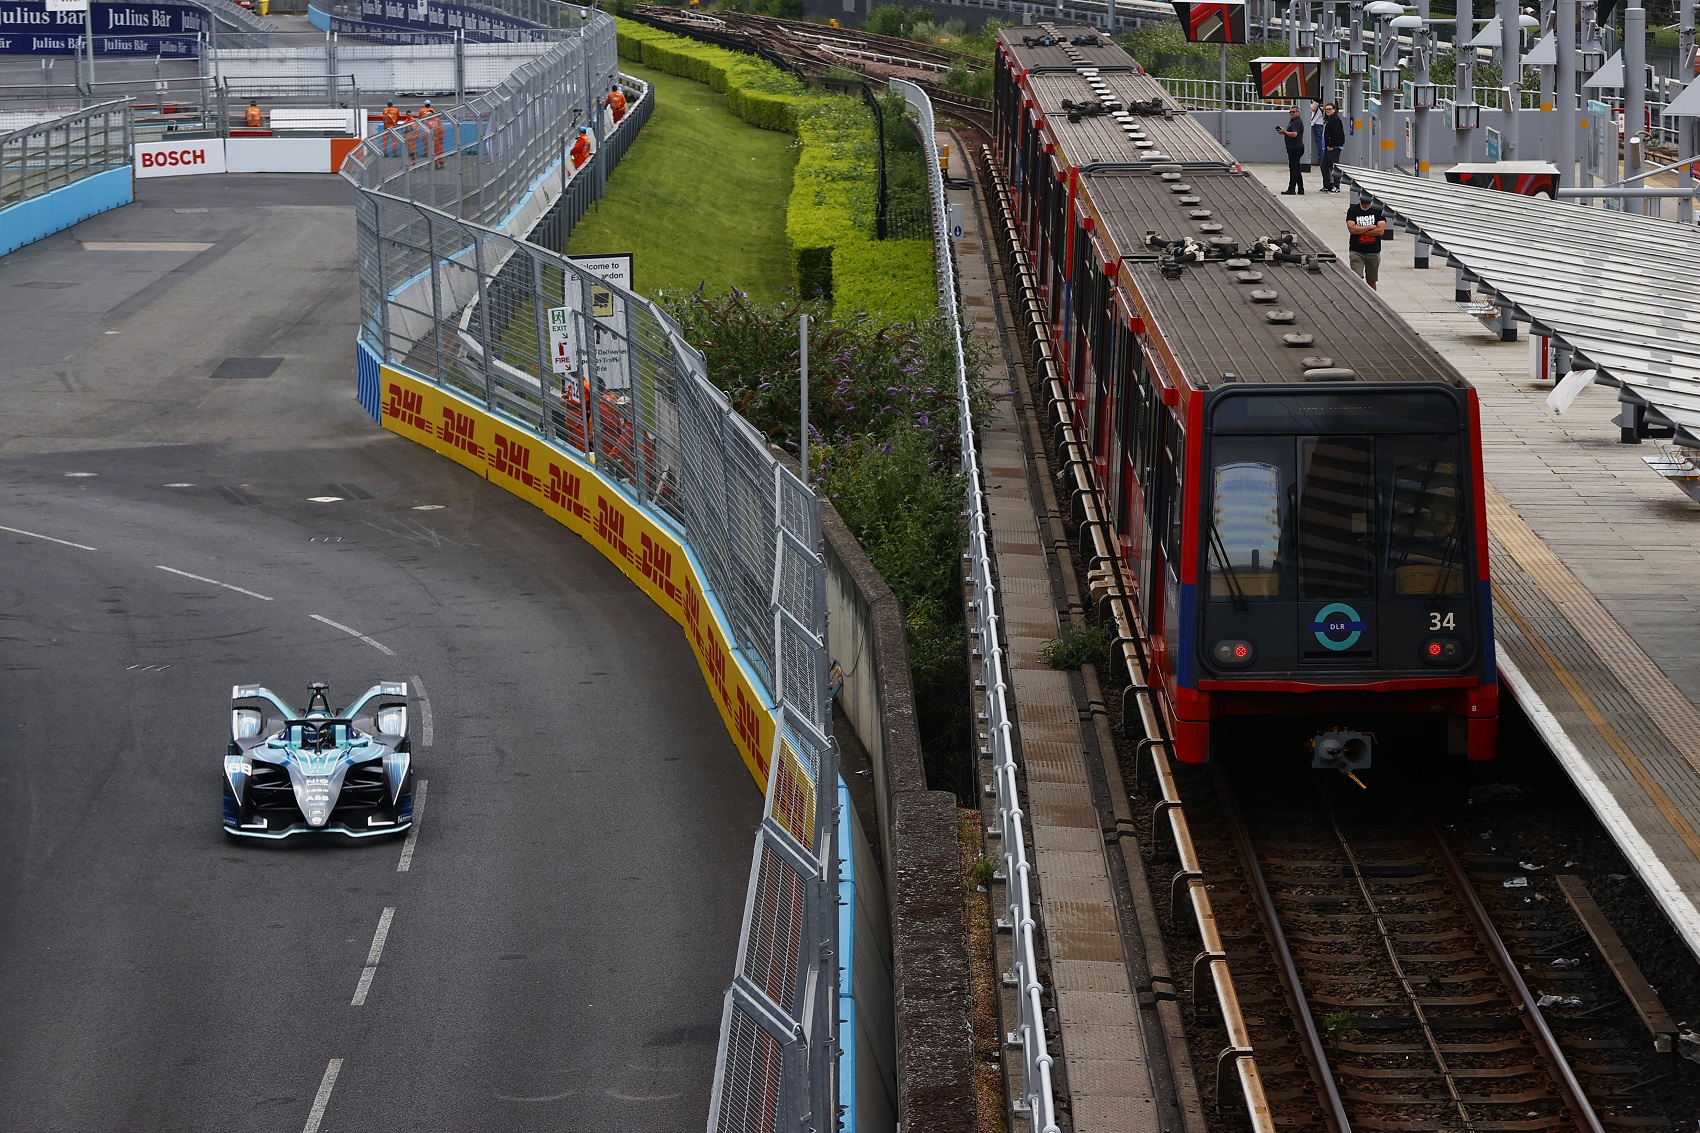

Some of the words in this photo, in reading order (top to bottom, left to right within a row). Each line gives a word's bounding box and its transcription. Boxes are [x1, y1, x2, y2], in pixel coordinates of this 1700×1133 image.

[0, 7, 50, 25] ulius
[108, 8, 149, 29] Julius
[152, 10, 172, 27] Bär
[0, 38, 12, 48] är
[32, 37, 65, 50] Julius
[104, 39, 132, 51] Julius
[134, 40, 148, 51] Bär
[141, 149, 205, 168] BOSCH
[389, 383, 426, 431] DHL
[443, 406, 478, 457] DHL
[494, 433, 533, 488] DHL
[549, 462, 584, 519] DHL
[598, 495, 628, 559] DHL
[641, 531, 676, 600] DHL
[685, 574, 701, 646] DHL
[1429, 612, 1456, 631] 34
[708, 624, 727, 710] DHL
[737, 684, 764, 774] DHL
